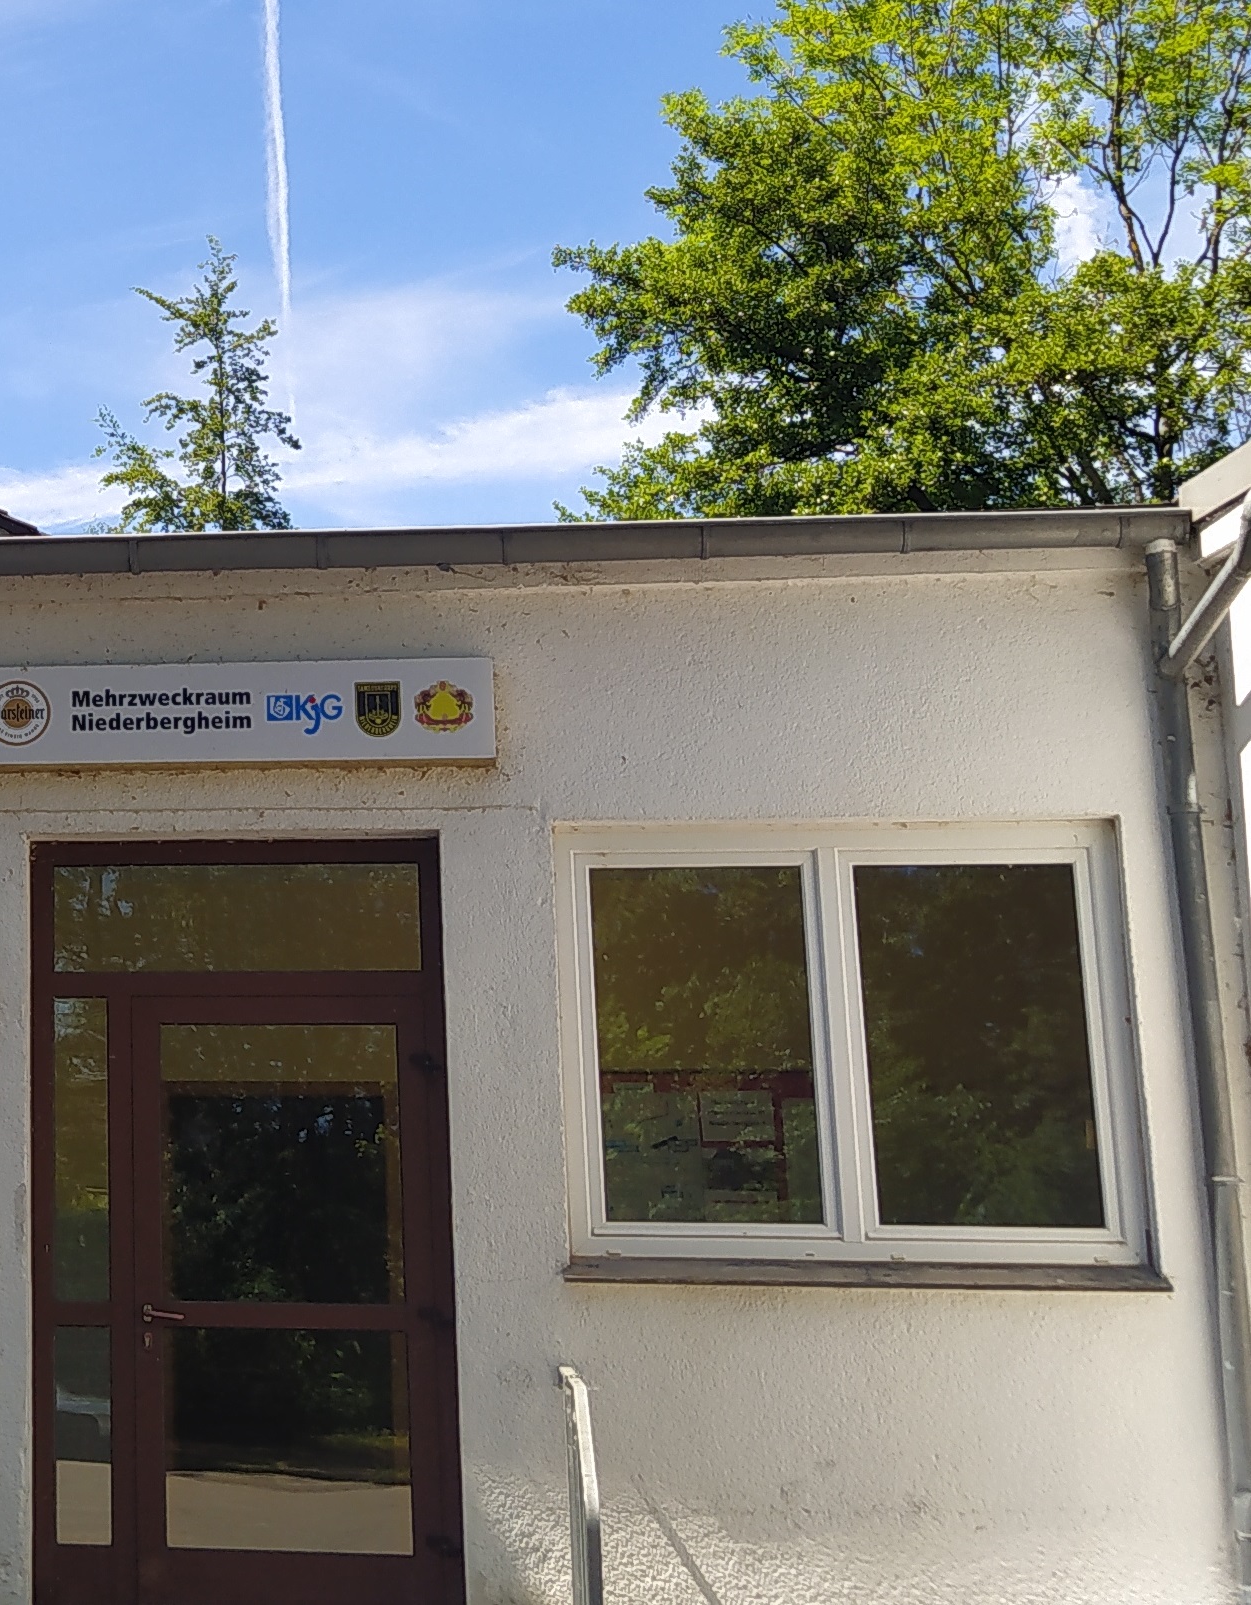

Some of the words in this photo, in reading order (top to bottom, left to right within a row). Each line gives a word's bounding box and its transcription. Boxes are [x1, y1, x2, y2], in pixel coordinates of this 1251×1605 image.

[71, 687, 252, 708] Mehrzweckraum
[71, 710, 252, 735] Niederbergheim
[294, 693, 343, 735] KjG
